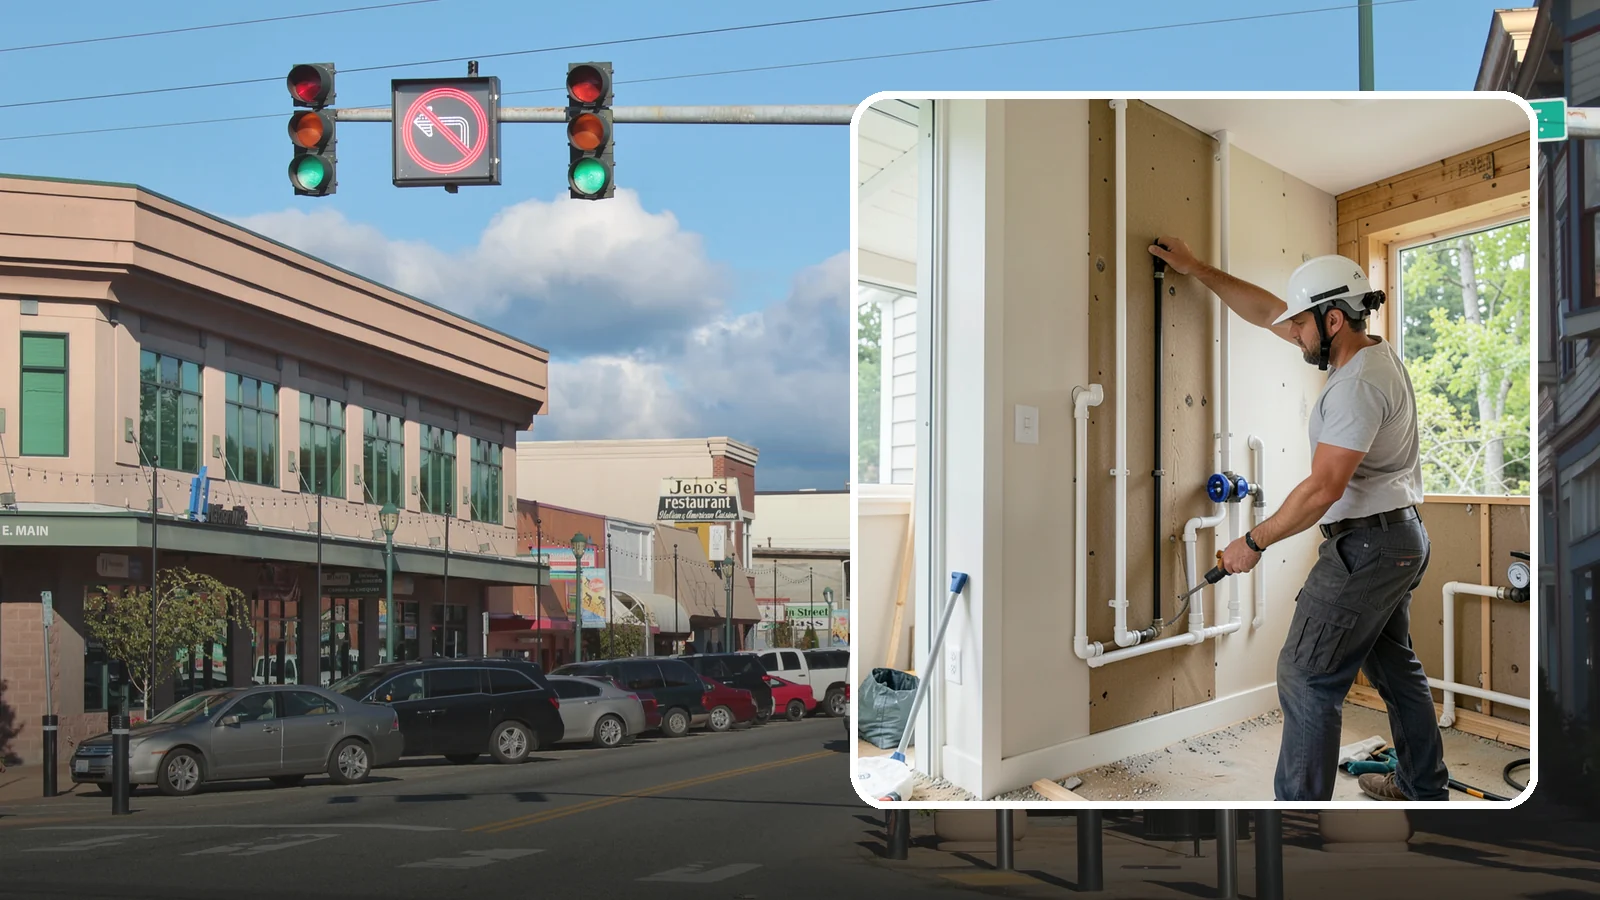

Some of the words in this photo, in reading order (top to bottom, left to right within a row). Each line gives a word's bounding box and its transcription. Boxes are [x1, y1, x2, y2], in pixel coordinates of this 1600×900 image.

[670, 480, 727, 495] Jeno's
[665, 496, 731, 509] restaurant
[658, 509, 681, 519] Italian
[686, 509, 715, 519] American
[715, 509, 738, 519] Cuisine
[2, 525, 13, 536] E.
[16, 525, 49, 536] MAIN
[797, 607, 829, 617] Street
